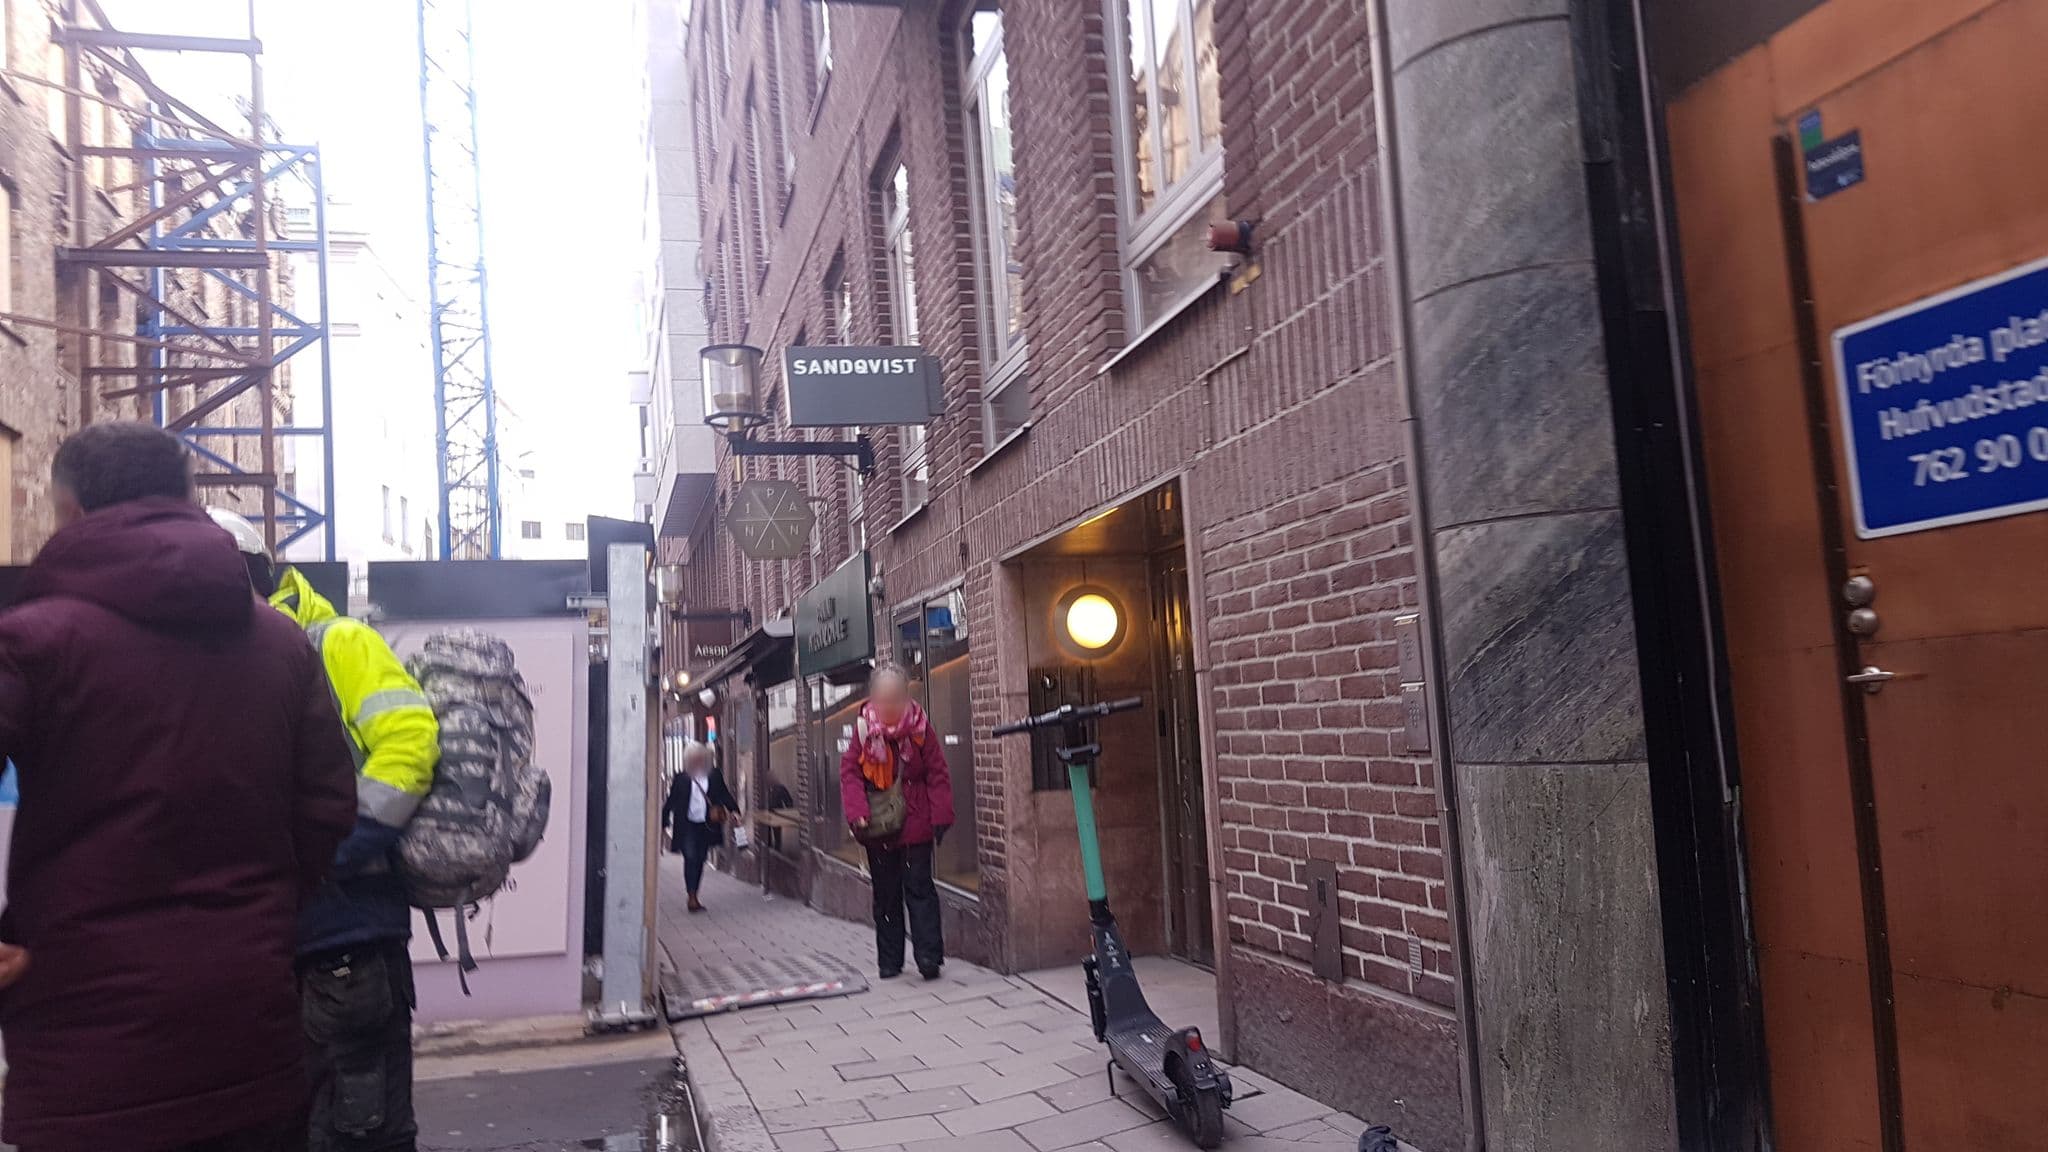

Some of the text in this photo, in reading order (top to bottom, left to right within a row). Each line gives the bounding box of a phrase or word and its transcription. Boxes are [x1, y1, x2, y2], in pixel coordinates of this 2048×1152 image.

[793, 358, 917, 375] SANDQVIST
[1856, 333, 1986, 394] Förhyrda
[1907, 446, 1970, 487] 762
[1974, 433, 2023, 473] 90
